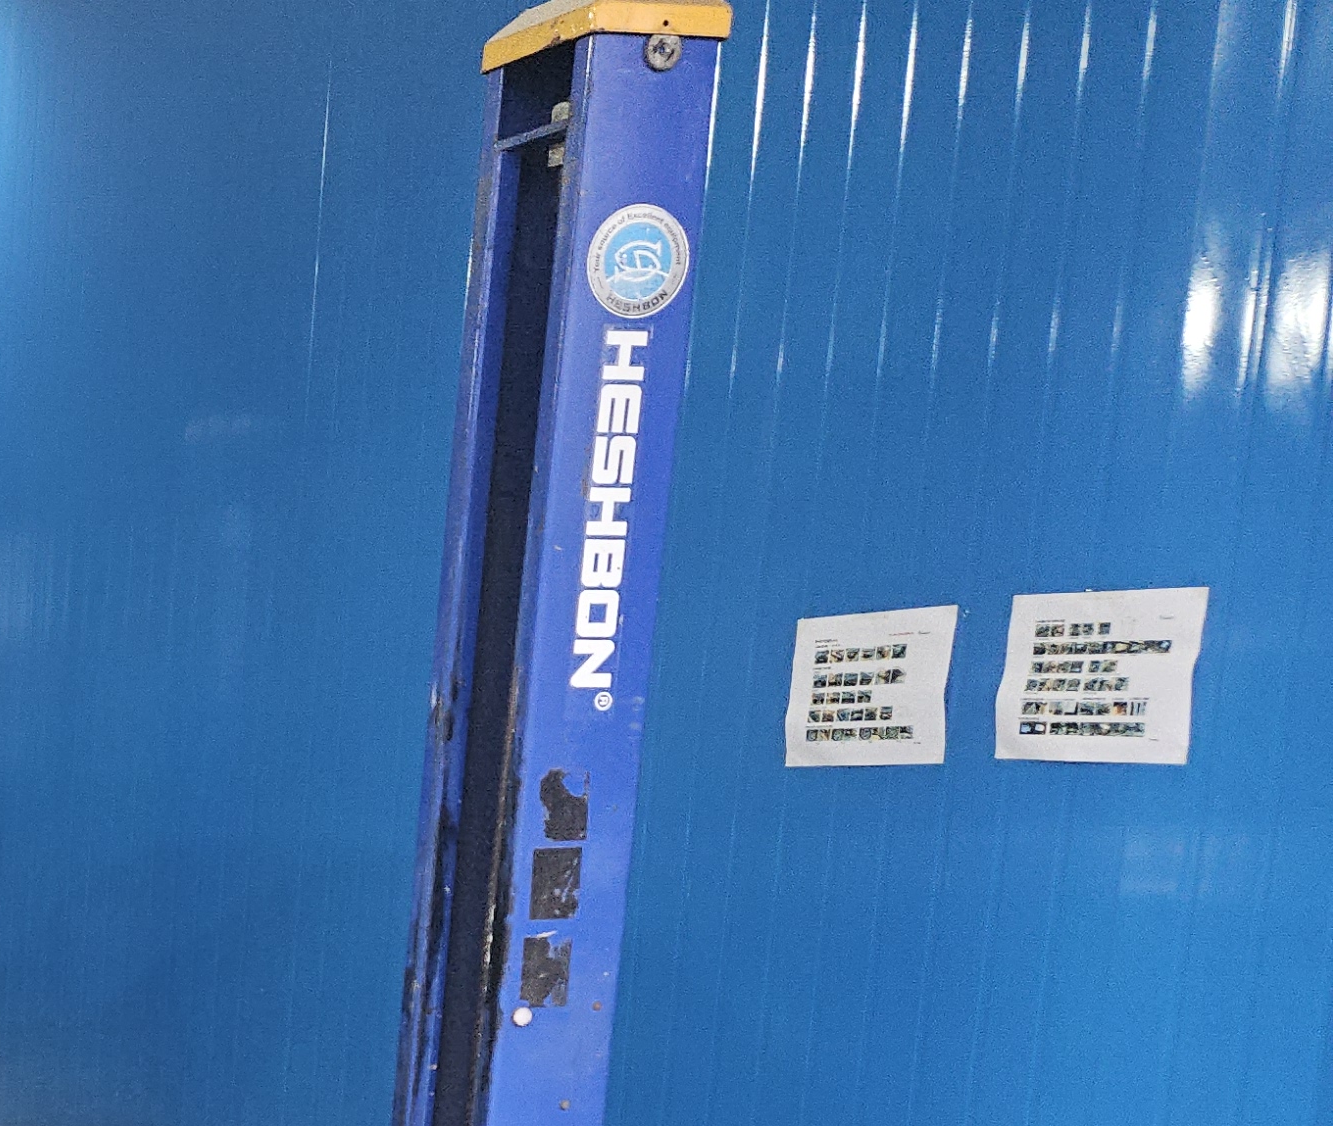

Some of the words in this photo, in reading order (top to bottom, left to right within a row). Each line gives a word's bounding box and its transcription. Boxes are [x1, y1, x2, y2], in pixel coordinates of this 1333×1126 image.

[599, 223, 618, 251] source
[617, 215, 626, 225] of
[664, 221, 682, 266] equipment
[606, 289, 668, 312] HESHBON
